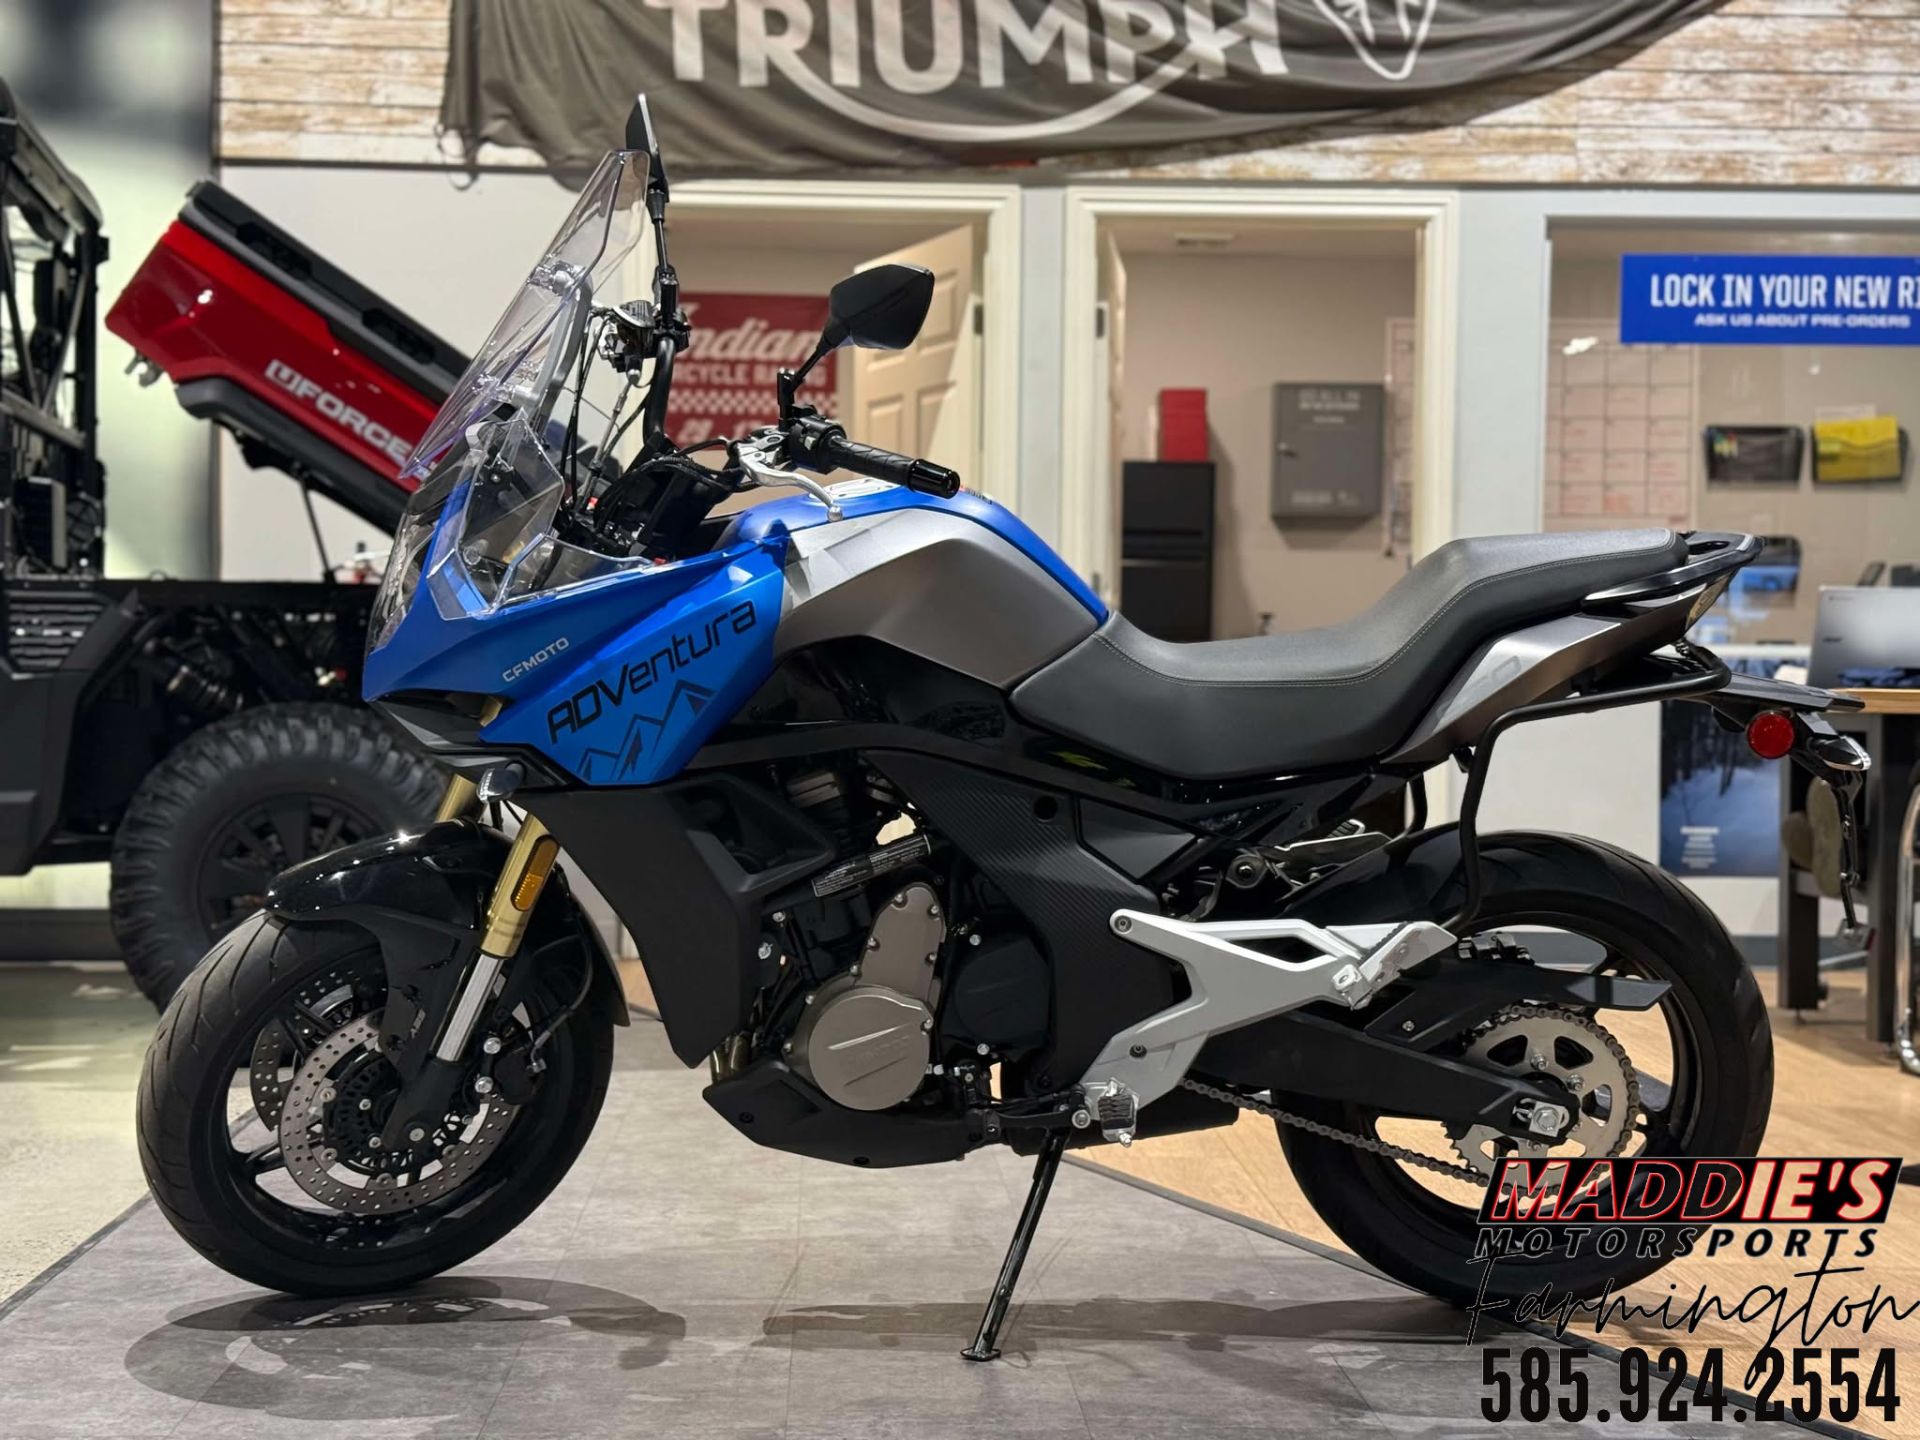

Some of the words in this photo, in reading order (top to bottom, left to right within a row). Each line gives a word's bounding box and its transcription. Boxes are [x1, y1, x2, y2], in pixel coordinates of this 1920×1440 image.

[644, 0, 1289, 95] TRIUMPH
[1650, 273, 1716, 308] LOCK
[1721, 274, 1753, 309] IN
[1759, 274, 1827, 309] YOUR
[1834, 274, 1891, 309] NEW
[1694, 313, 1727, 327] ASK
[1730, 313, 1753, 327] US
[1755, 313, 1808, 328] ABOUT
[1811, 314, 1911, 329] PRE-ORDERS
[502, 637, 570, 683] CFMOTO
[546, 599, 757, 744] ADVentura
